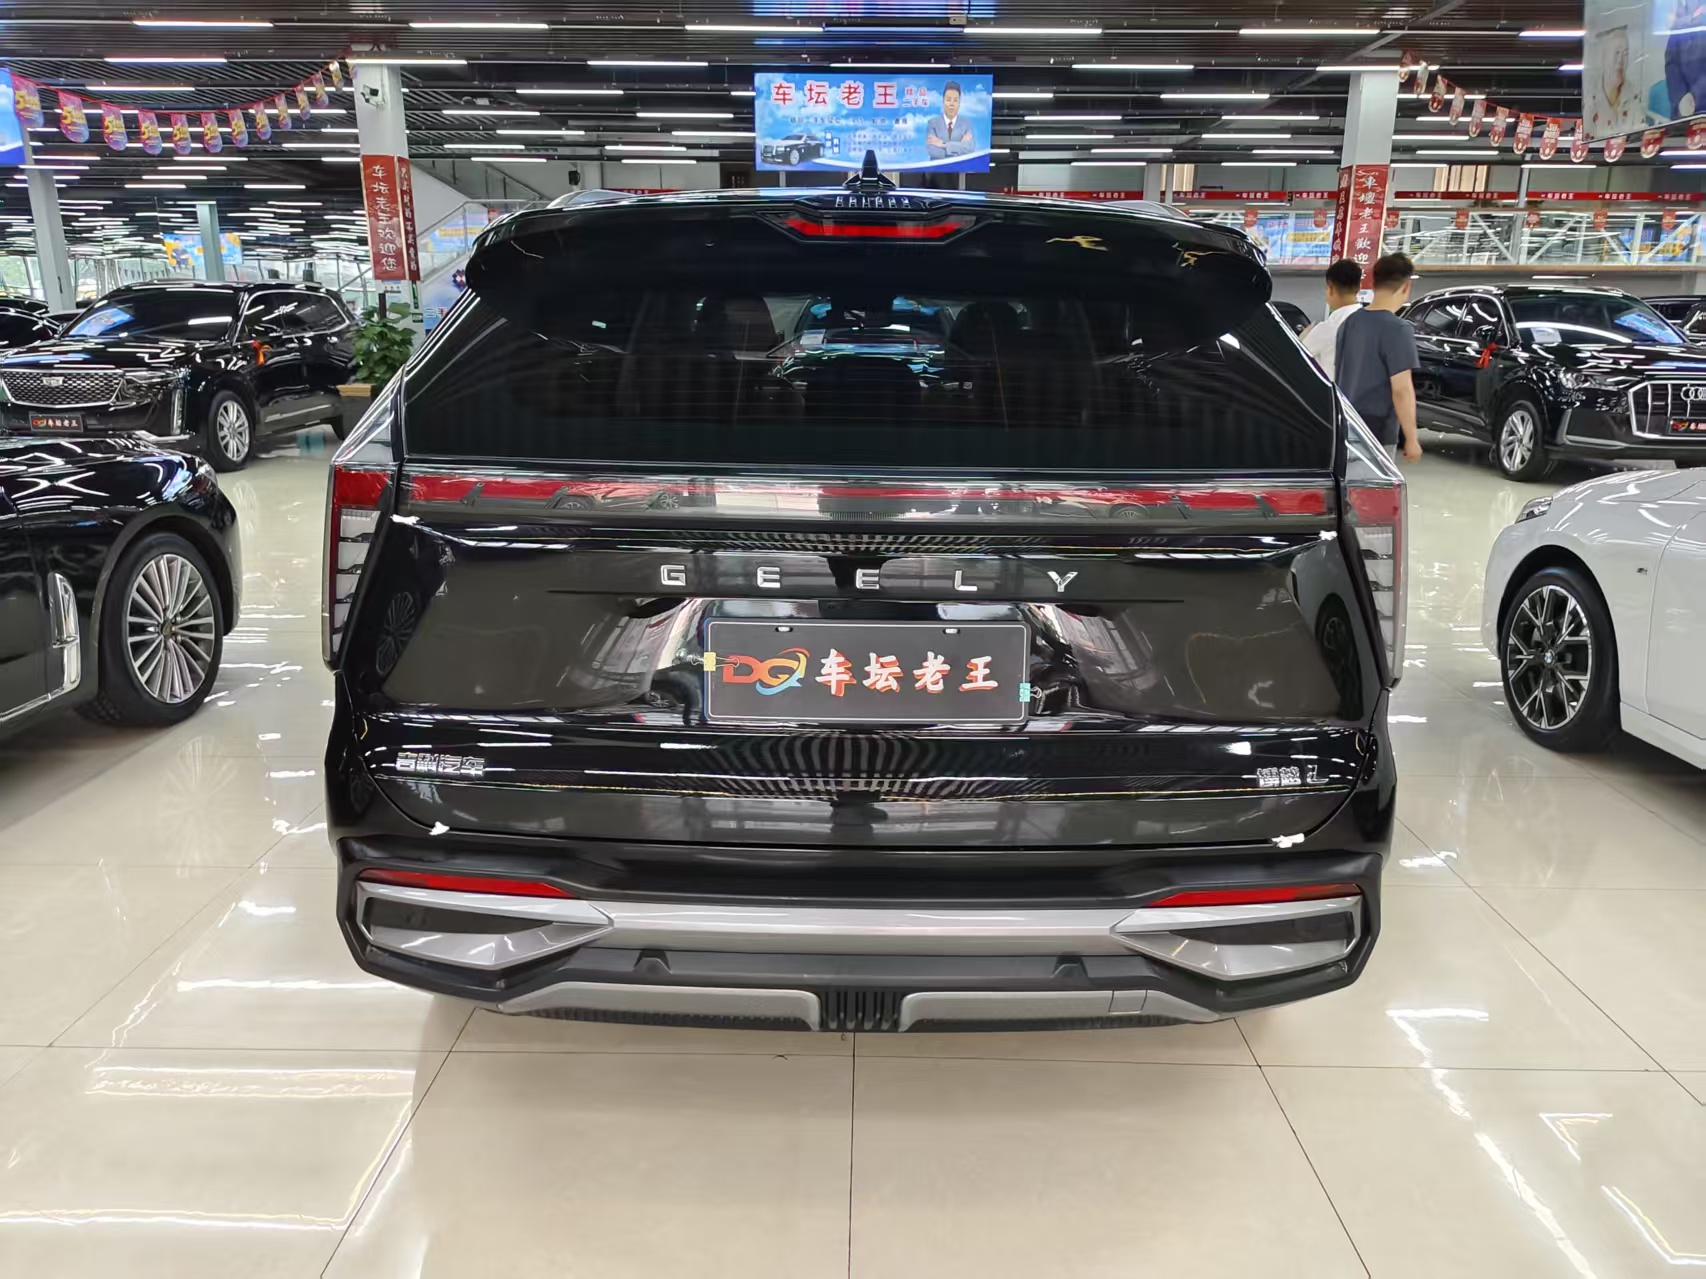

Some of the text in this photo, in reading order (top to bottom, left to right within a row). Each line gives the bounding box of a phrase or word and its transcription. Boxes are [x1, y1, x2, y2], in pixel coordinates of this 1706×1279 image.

[773, 82, 897, 106] 车坛老王
[371, 164, 398, 272] 车坛老王欢迎您
[1353, 175, 1378, 279] 車壇老王歡迎
[660, 564, 1079, 593] GEELY
[815, 648, 999, 697] 车坛老王
[396, 752, 485, 776] 吉利汽车
